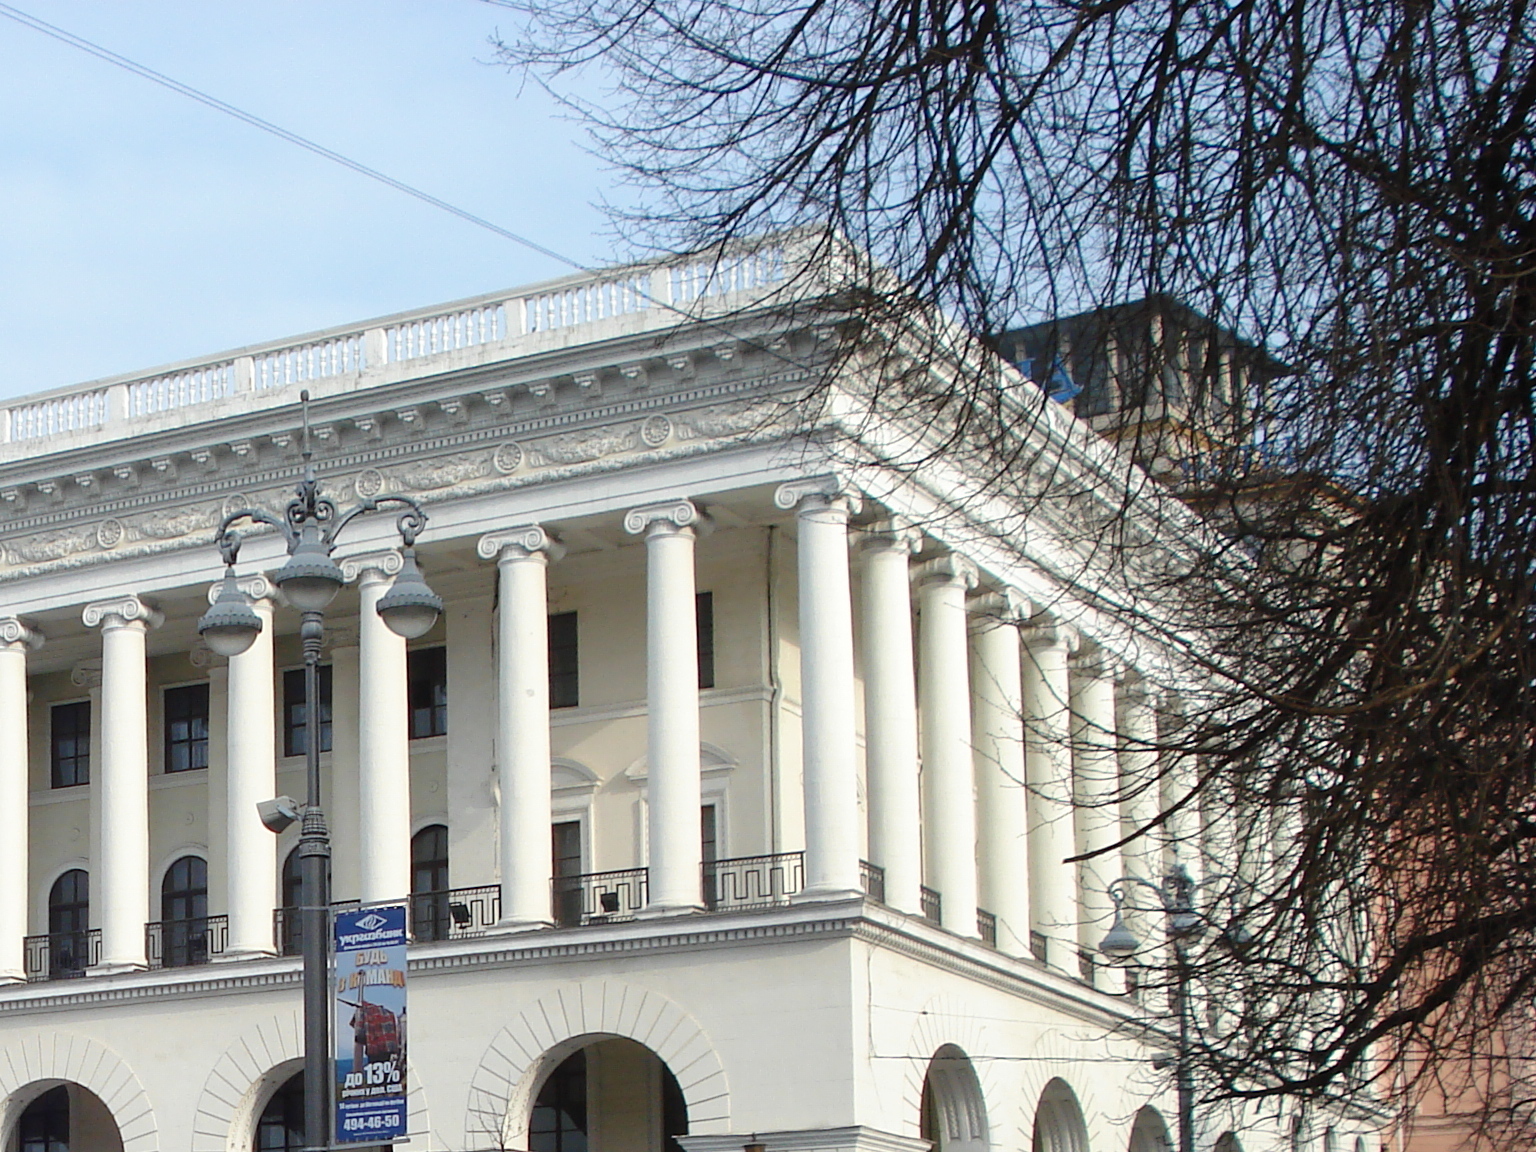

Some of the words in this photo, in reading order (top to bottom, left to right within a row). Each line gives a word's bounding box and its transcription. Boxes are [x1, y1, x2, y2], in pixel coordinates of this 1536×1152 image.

[355, 950, 388, 967] БУДЬ
[364, 1061, 400, 1085] 13%
[343, 1114, 400, 1131] 494-46-50
